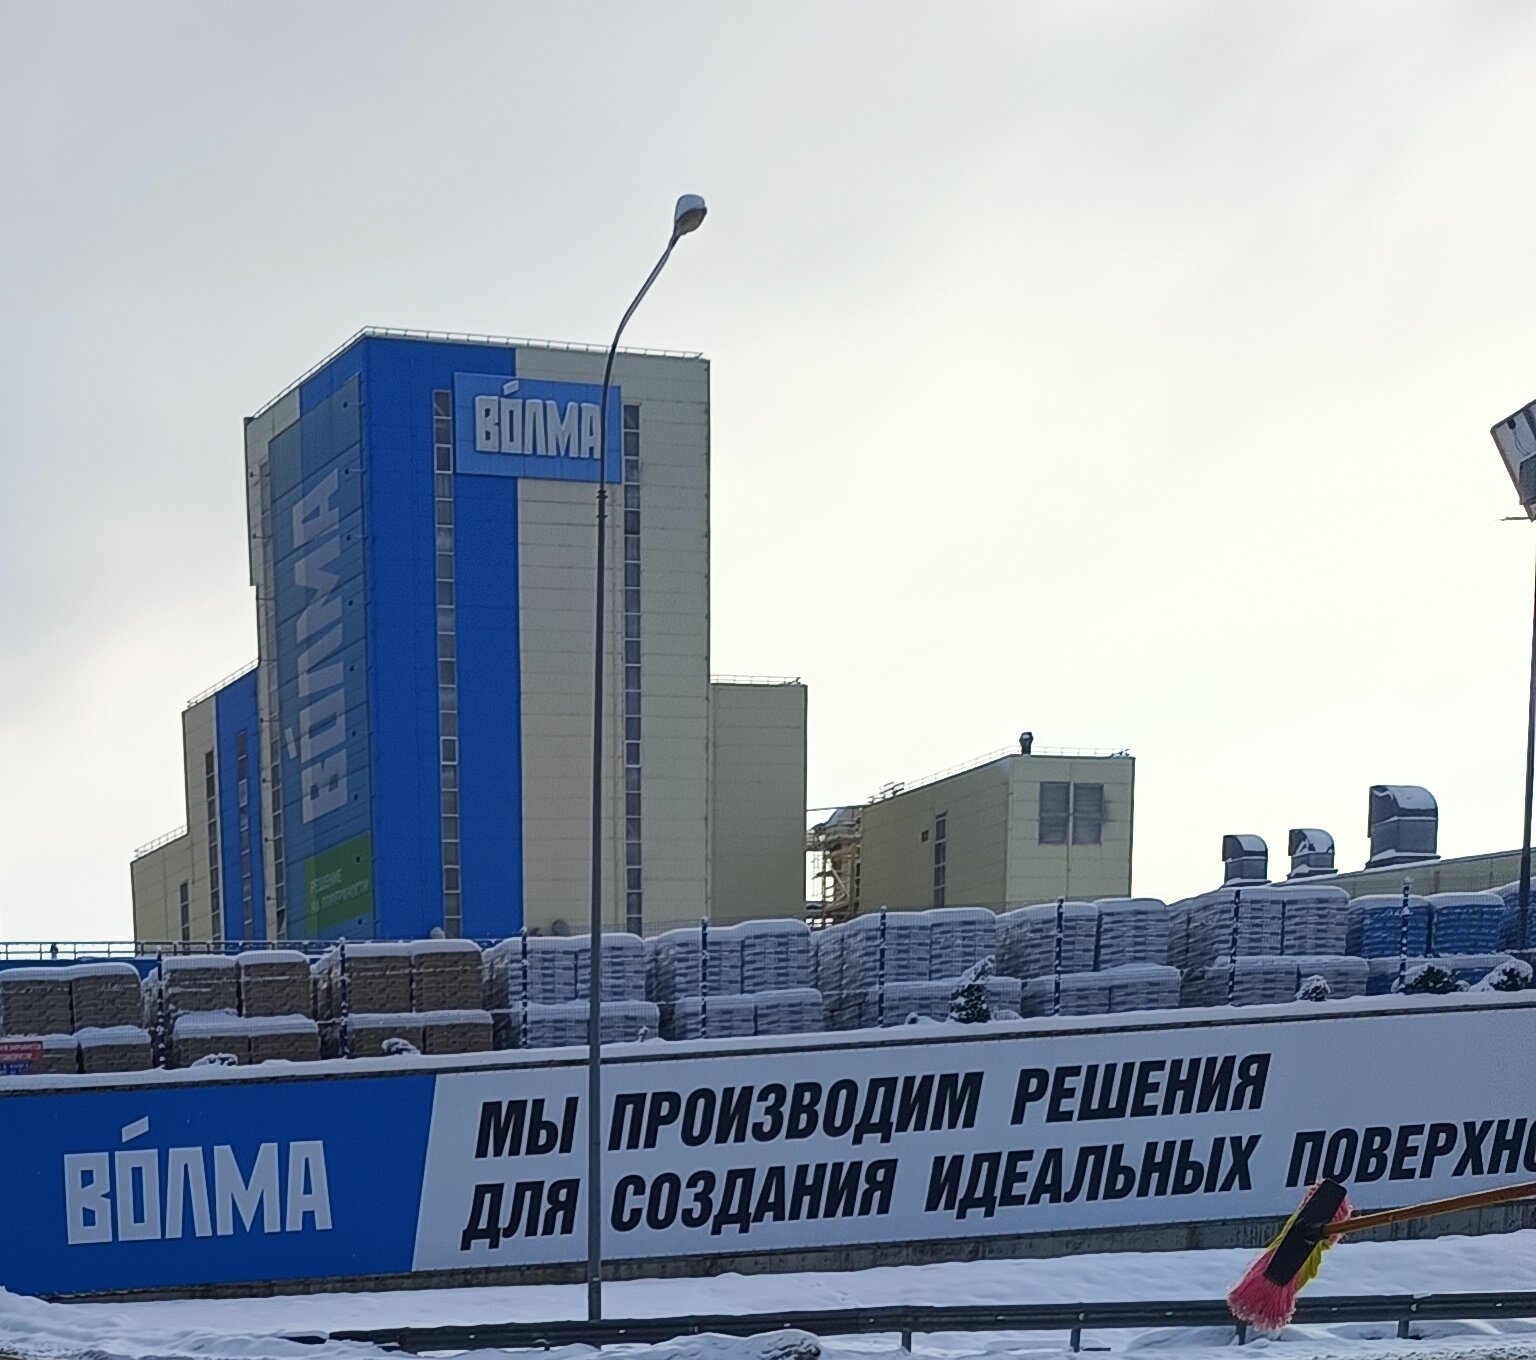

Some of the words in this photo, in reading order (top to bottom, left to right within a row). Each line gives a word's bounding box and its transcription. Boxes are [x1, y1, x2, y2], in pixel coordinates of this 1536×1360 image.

[475, 1096, 580, 1159] МЫ
[608, 1071, 984, 1151] ПРОИЗВОДИМ
[1010, 1053, 1271, 1126] РЕШЕНИЯ
[460, 1178, 581, 1251] ДЛЯ
[611, 1159, 898, 1236] СОЗДАНИЯ
[924, 1134, 1262, 1220] ИДЕАЛЬНЫХ
